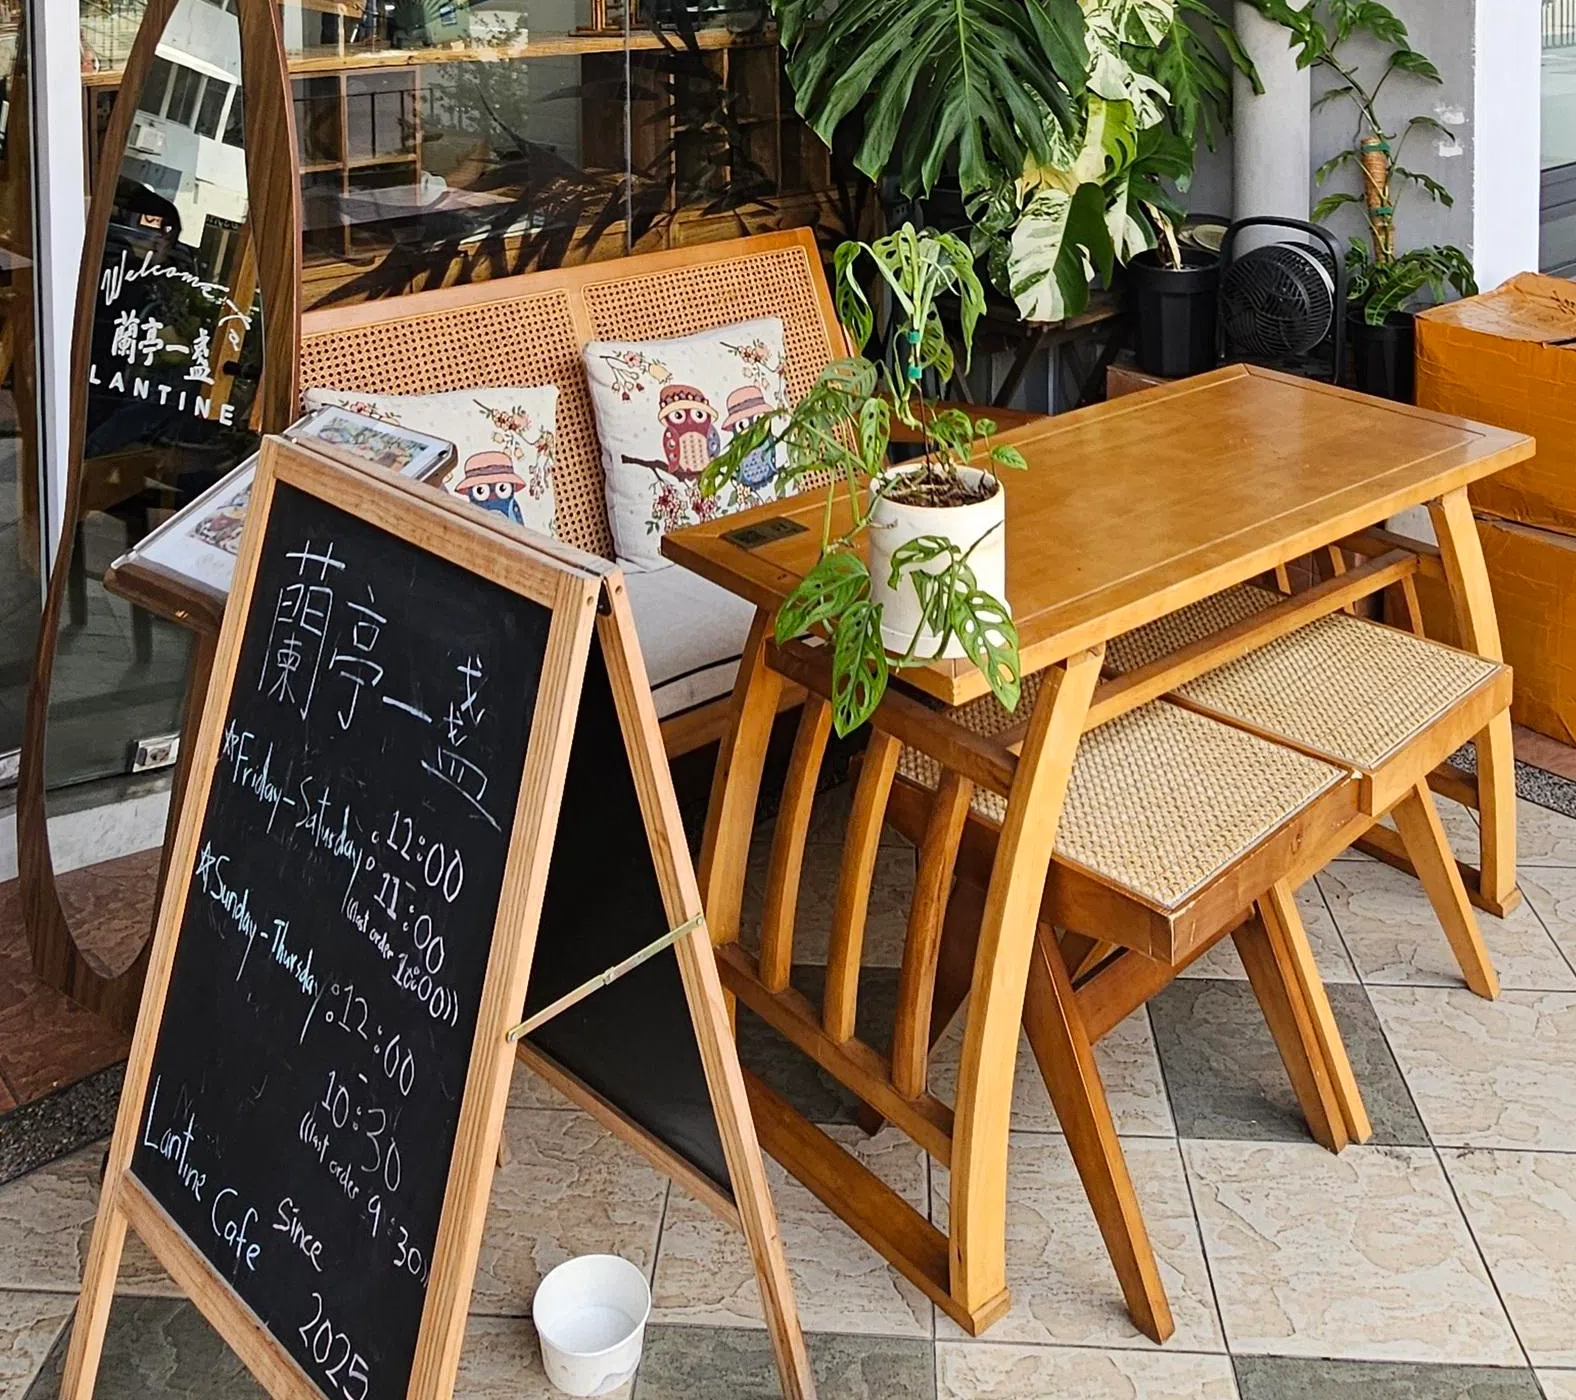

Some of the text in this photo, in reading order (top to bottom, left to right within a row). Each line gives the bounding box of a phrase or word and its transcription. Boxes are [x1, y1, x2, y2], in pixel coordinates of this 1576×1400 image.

[101, 250, 222, 306] Welcome
[89, 364, 236, 427] LANTINE
[387, 810, 464, 903] 12:00
[374, 873, 445, 975] 11:00
[338, 984, 415, 1096] 12:00
[143, 1075, 261, 1272] Lantine Cafe
[321, 1070, 401, 1192] 10:30
[272, 1197, 323, 1273] Since
[299, 1292, 369, 1400] 2025
